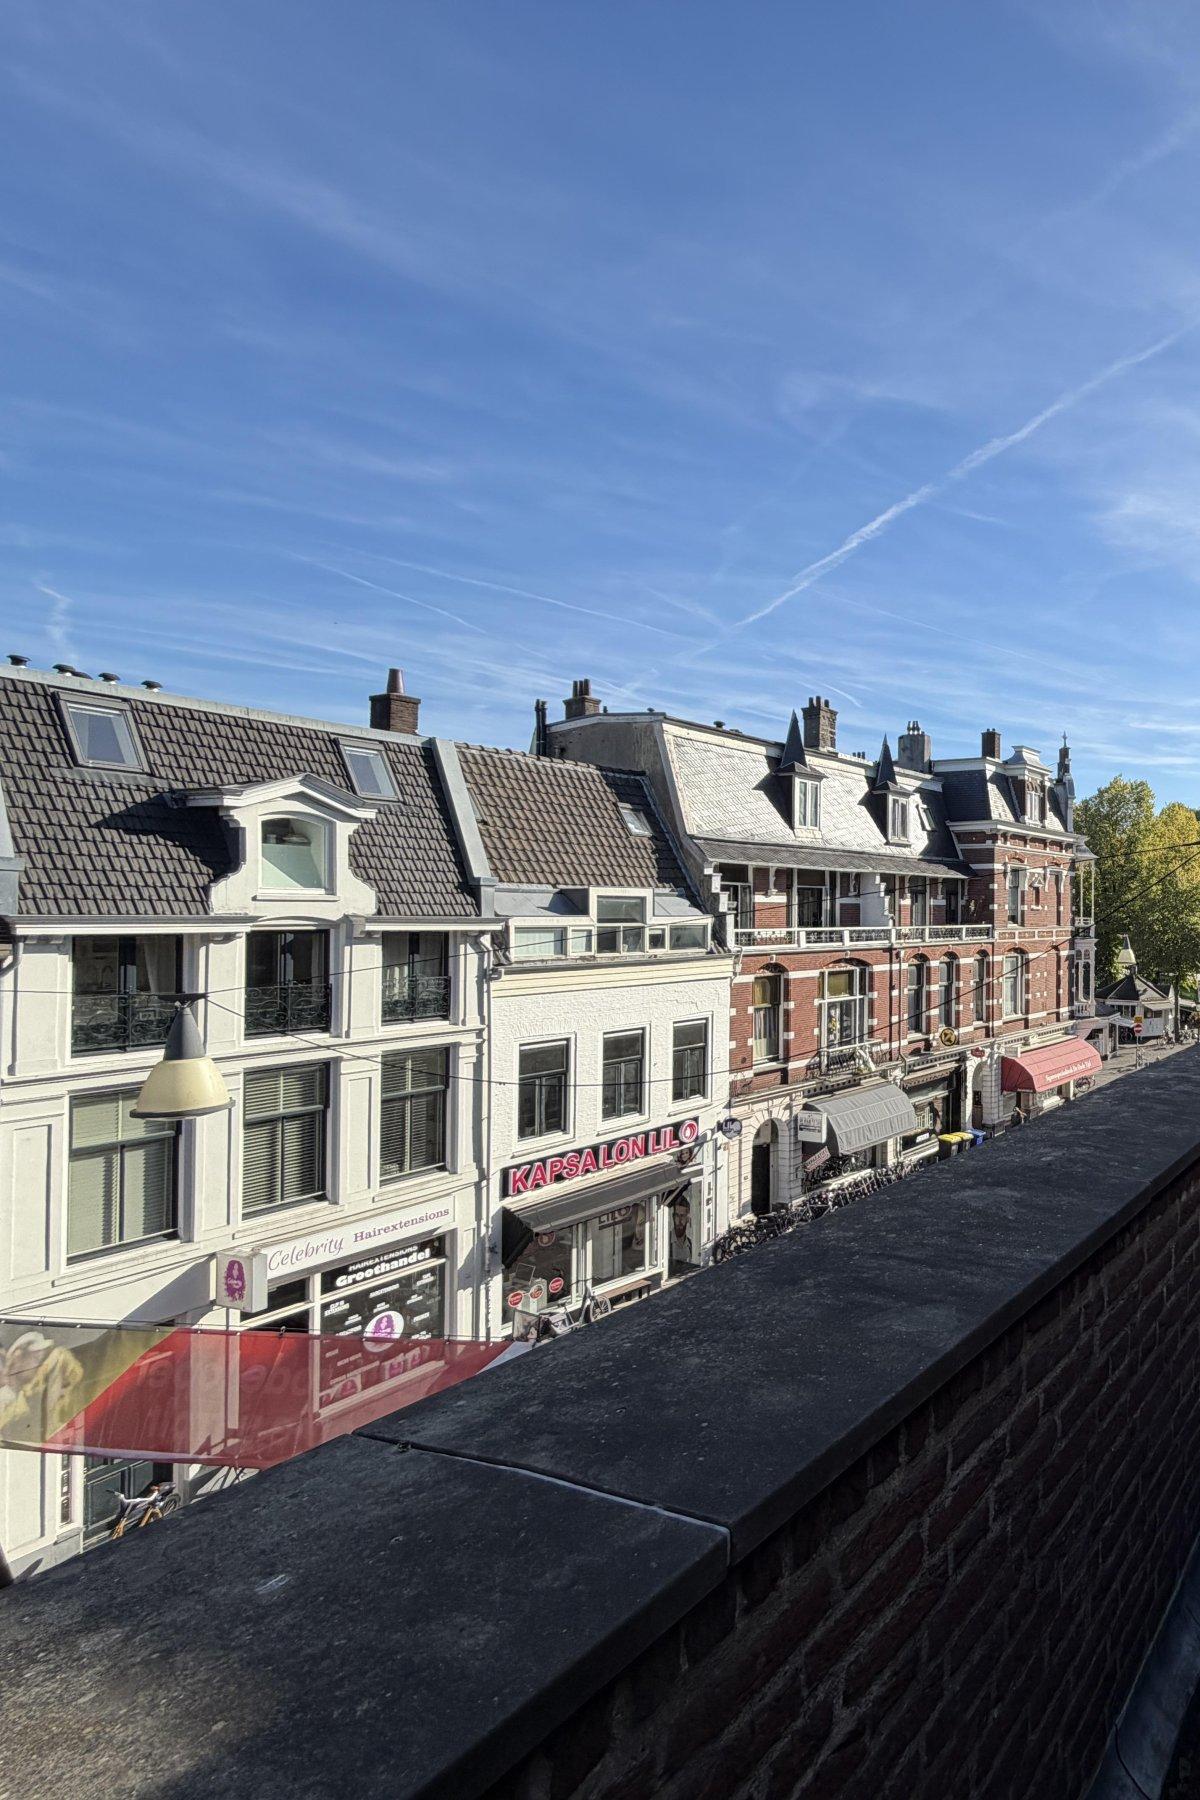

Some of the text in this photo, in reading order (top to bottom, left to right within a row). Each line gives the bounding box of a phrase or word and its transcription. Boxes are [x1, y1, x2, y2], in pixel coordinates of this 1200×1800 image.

[269, 1207, 450, 1271] Celebrity Hairextensions
[335, 1248, 431, 1287] Groothandel
